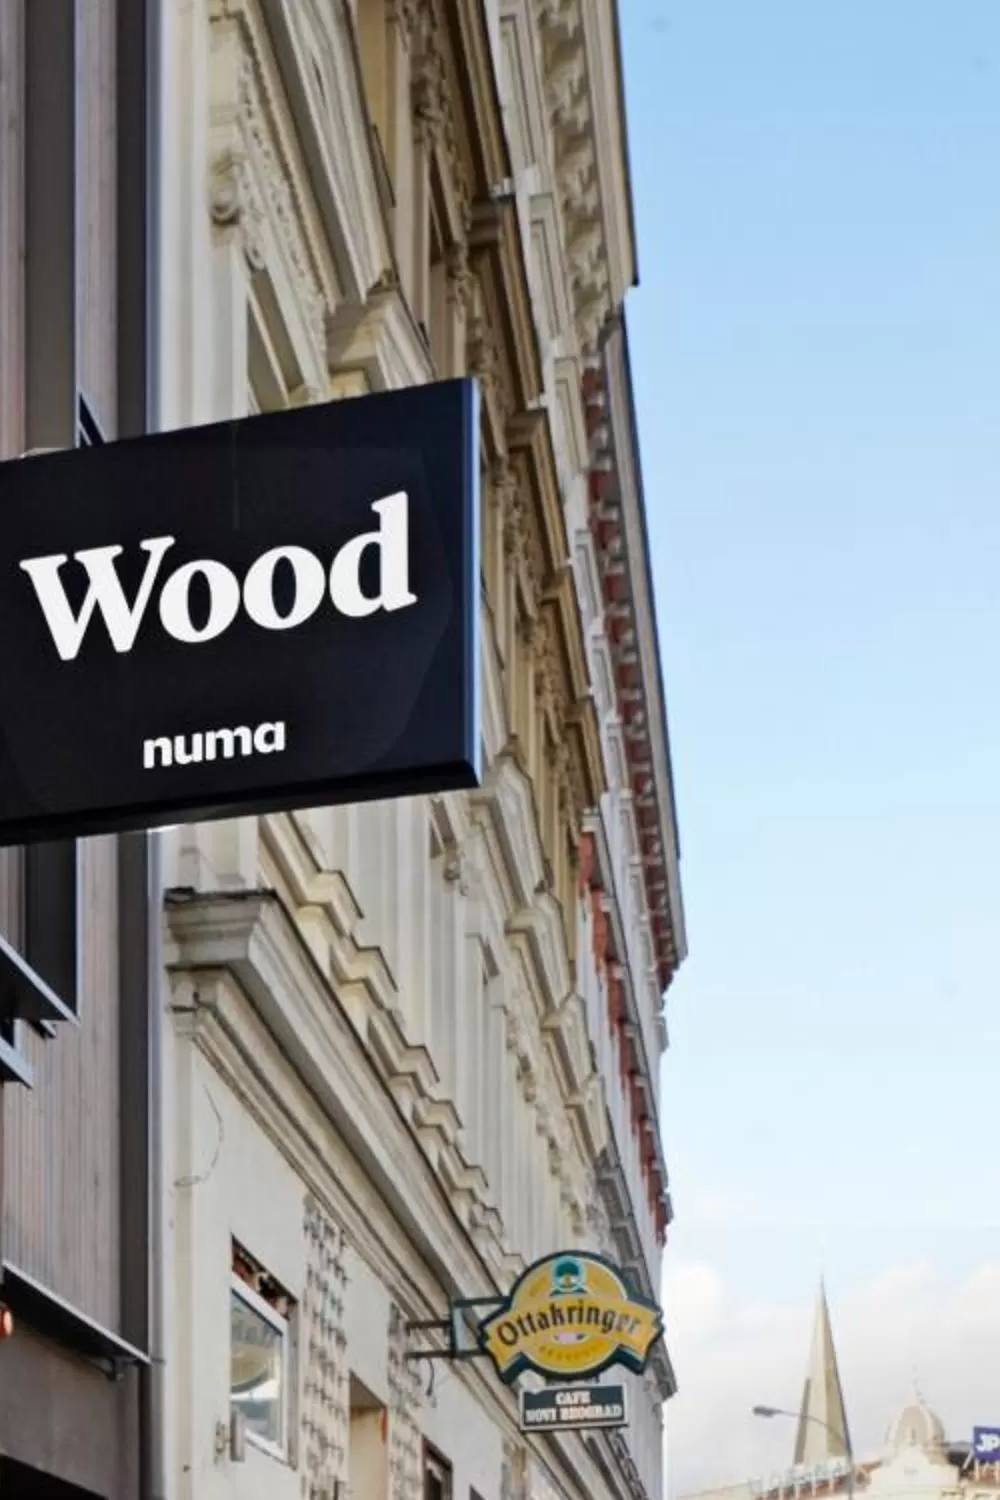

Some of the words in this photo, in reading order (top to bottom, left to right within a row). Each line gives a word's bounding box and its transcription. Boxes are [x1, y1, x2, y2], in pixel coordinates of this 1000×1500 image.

[19, 490, 417, 661] Wood
[143, 721, 286, 769] numa
[497, 1301, 641, 1346] Ottakringer
